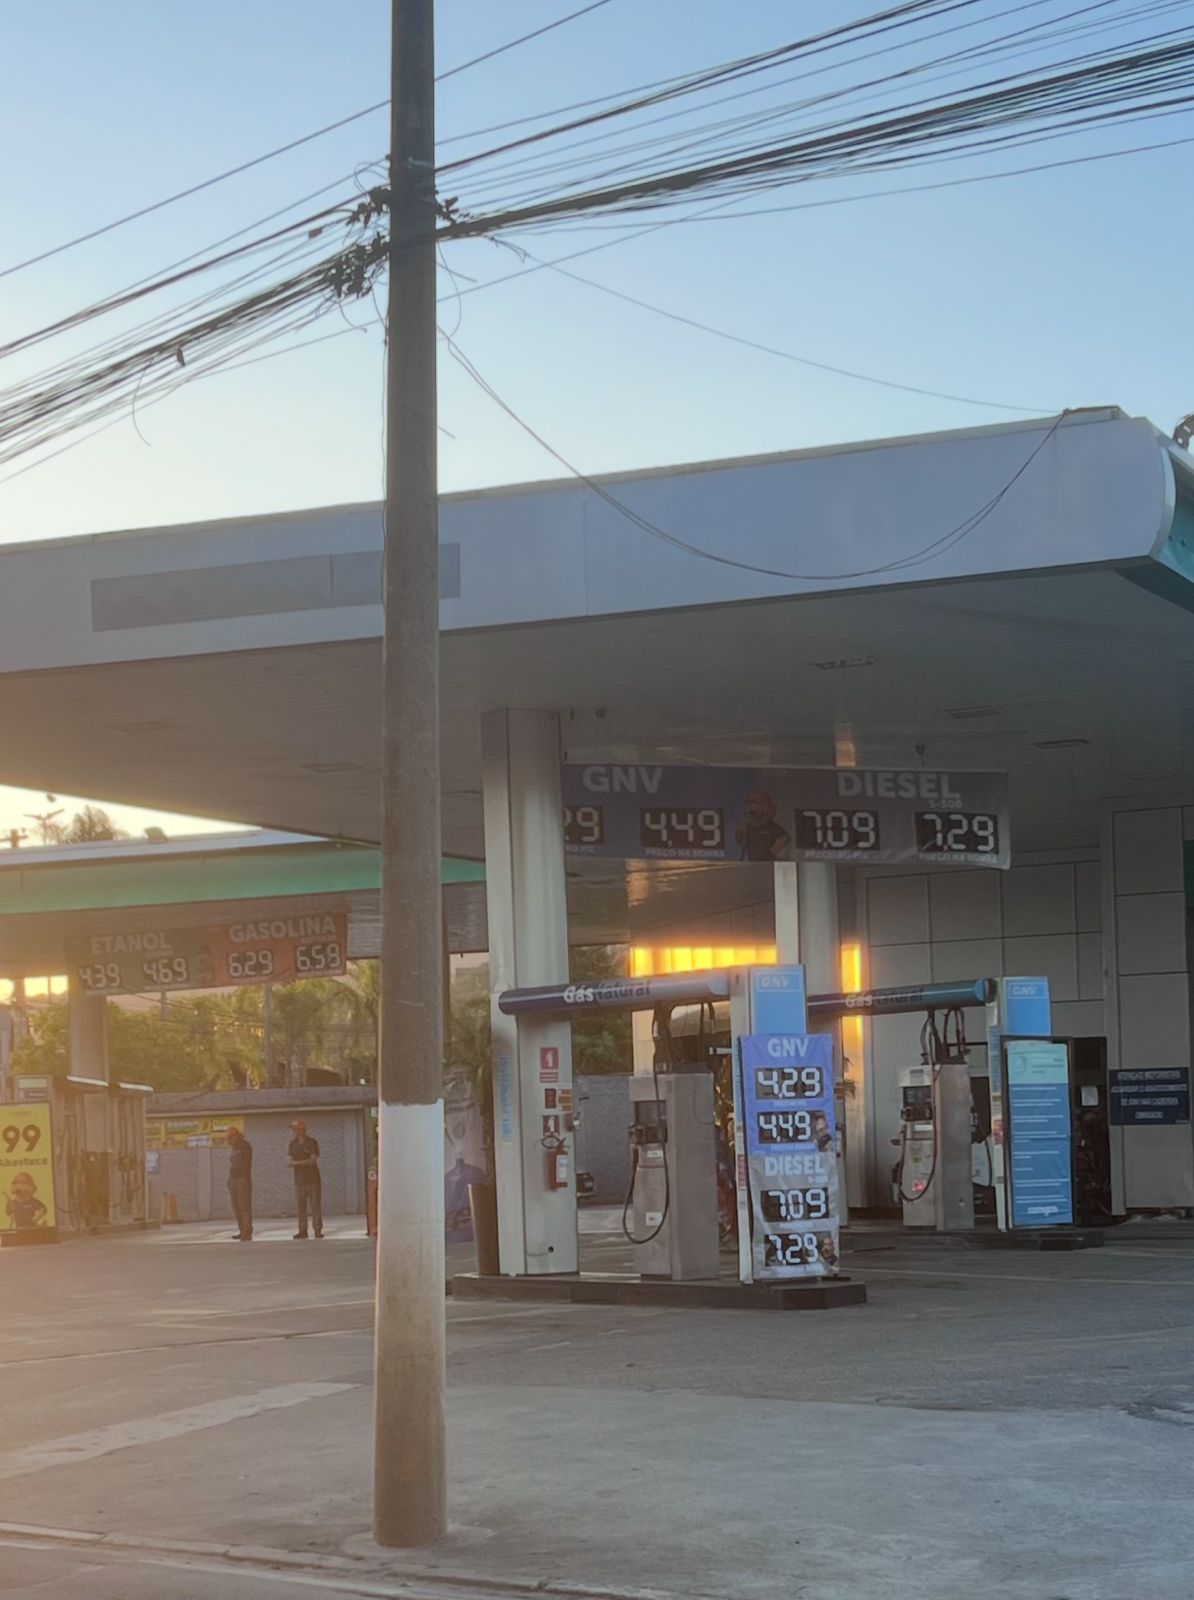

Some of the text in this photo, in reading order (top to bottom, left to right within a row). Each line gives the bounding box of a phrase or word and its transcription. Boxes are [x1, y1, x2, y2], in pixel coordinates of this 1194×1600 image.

[581, 766, 663, 794] GNV
[836, 771, 961, 799] DIESEL
[645, 809, 721, 847] 4,49
[803, 811, 876, 848] 7,09
[923, 813, 995, 852] 7,29
[90, 931, 172, 955] ETANOL
[229, 916, 336, 942] GASOLINA
[761, 975, 789, 988] GNV
[767, 1038, 809, 1058] GNV
[757, 1068, 820, 1099] 4,29
[759, 1111, 812, 1142] 4,49
[764, 1155, 826, 1177] DIESEL
[768, 1189, 826, 1221] 7,09
[769, 1233, 818, 1265] 7,29
